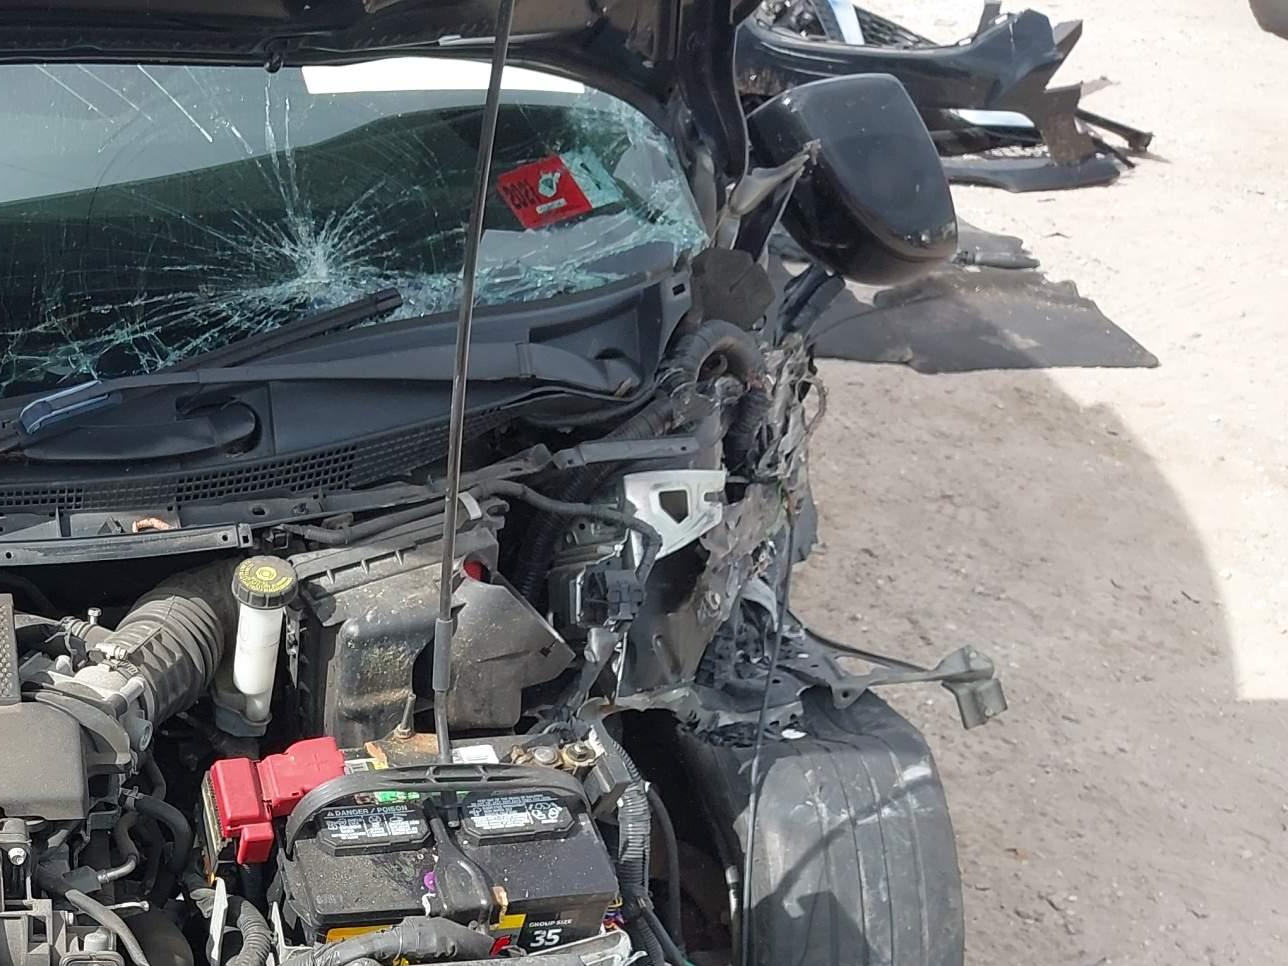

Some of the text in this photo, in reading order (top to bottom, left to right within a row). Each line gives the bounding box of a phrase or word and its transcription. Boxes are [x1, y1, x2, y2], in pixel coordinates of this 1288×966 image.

[334, 808, 369, 817] DANGER
[376, 804, 408, 814] POISON
[528, 920, 556, 928] GROUP
[529, 928, 562, 947] 35
